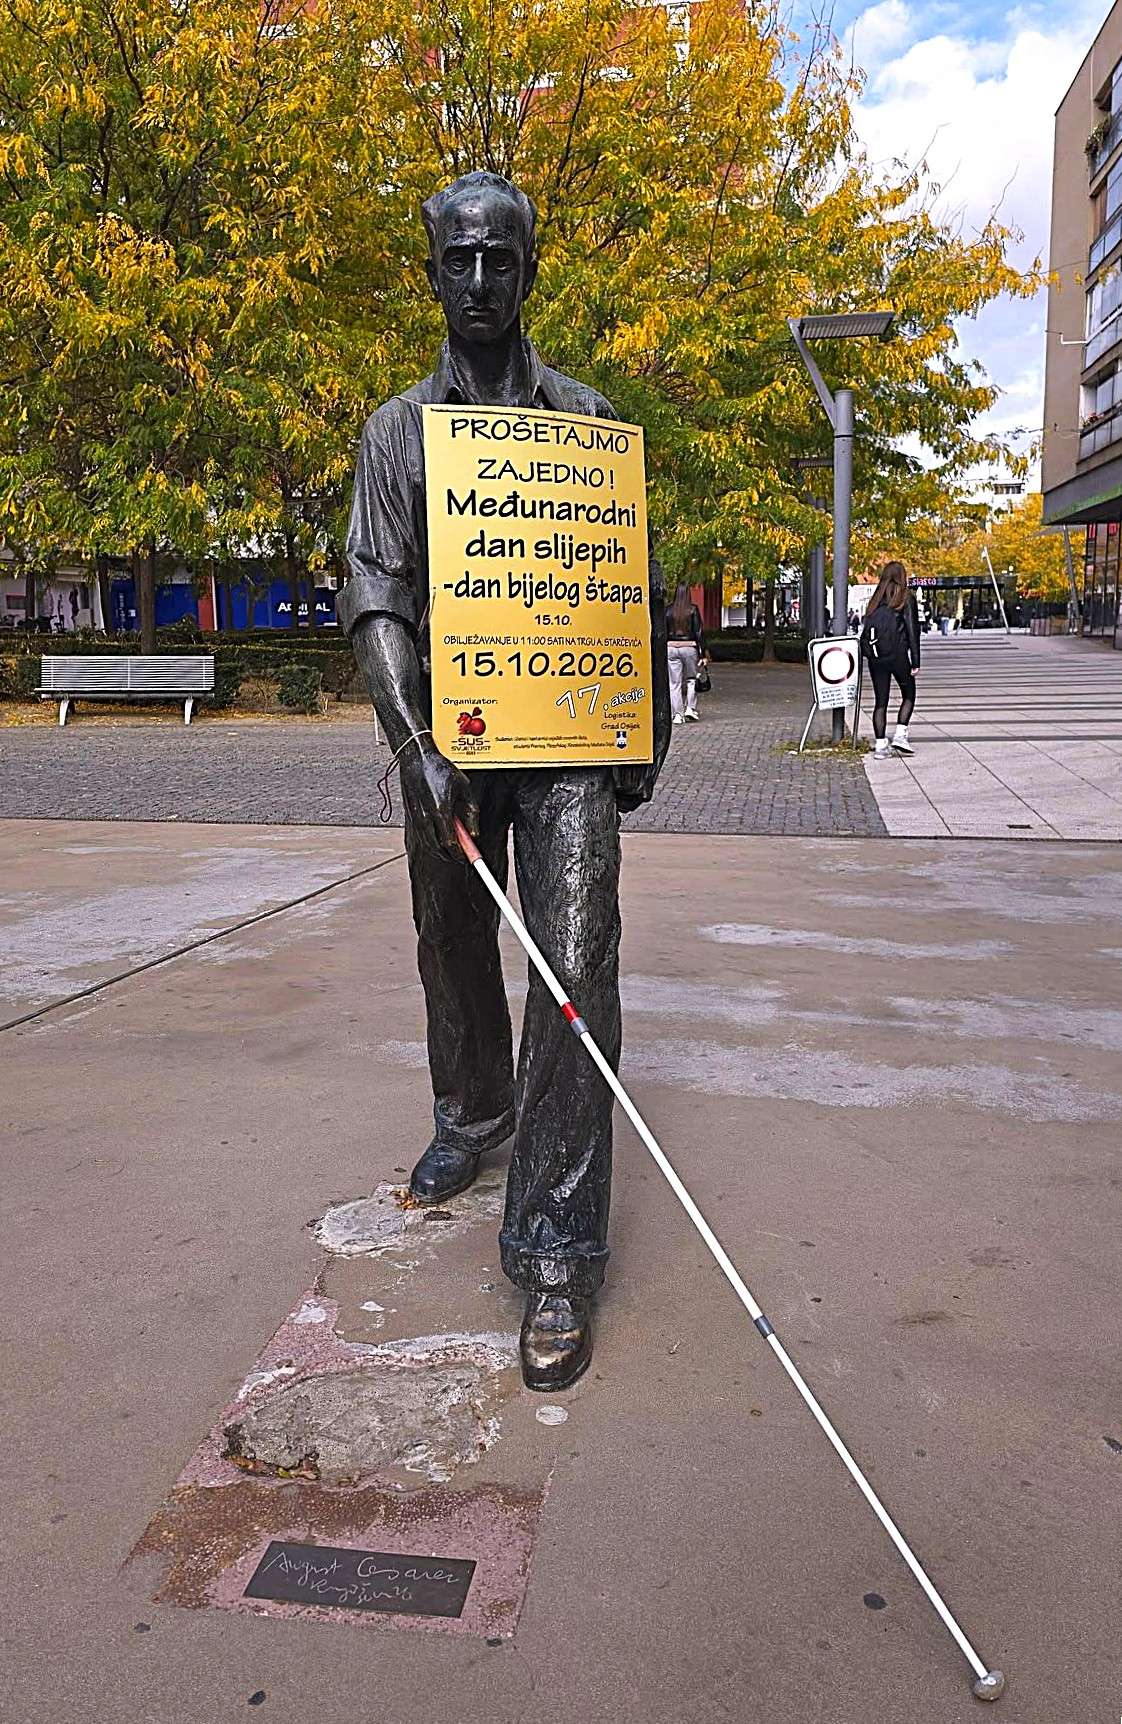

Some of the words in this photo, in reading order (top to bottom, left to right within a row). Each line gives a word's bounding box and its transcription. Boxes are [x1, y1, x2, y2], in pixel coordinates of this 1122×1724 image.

[451, 415, 629, 454] PROŠETAJMO
[447, 489, 636, 528] Međunarodni
[465, 530, 525, 558] dan
[534, 533, 626, 573] slijepih
[508, 572, 579, 609] bijelog
[586, 576, 642, 613] štapa
[534, 614, 573, 626] 15.10.
[443, 634, 511, 645] OBILJEŽAVANJE
[513, 636, 519, 645] U
[547, 636, 564, 646] SATI
[565, 636, 576, 646] NA
[577, 637, 595, 647] TRGU
[452, 651, 638, 678] 15.10.2026.
[442, 697, 499, 706] Organizator:
[611, 687, 646, 708] akcija
[601, 722, 619, 730] Grad
[262, 1552, 343, 1585] August
